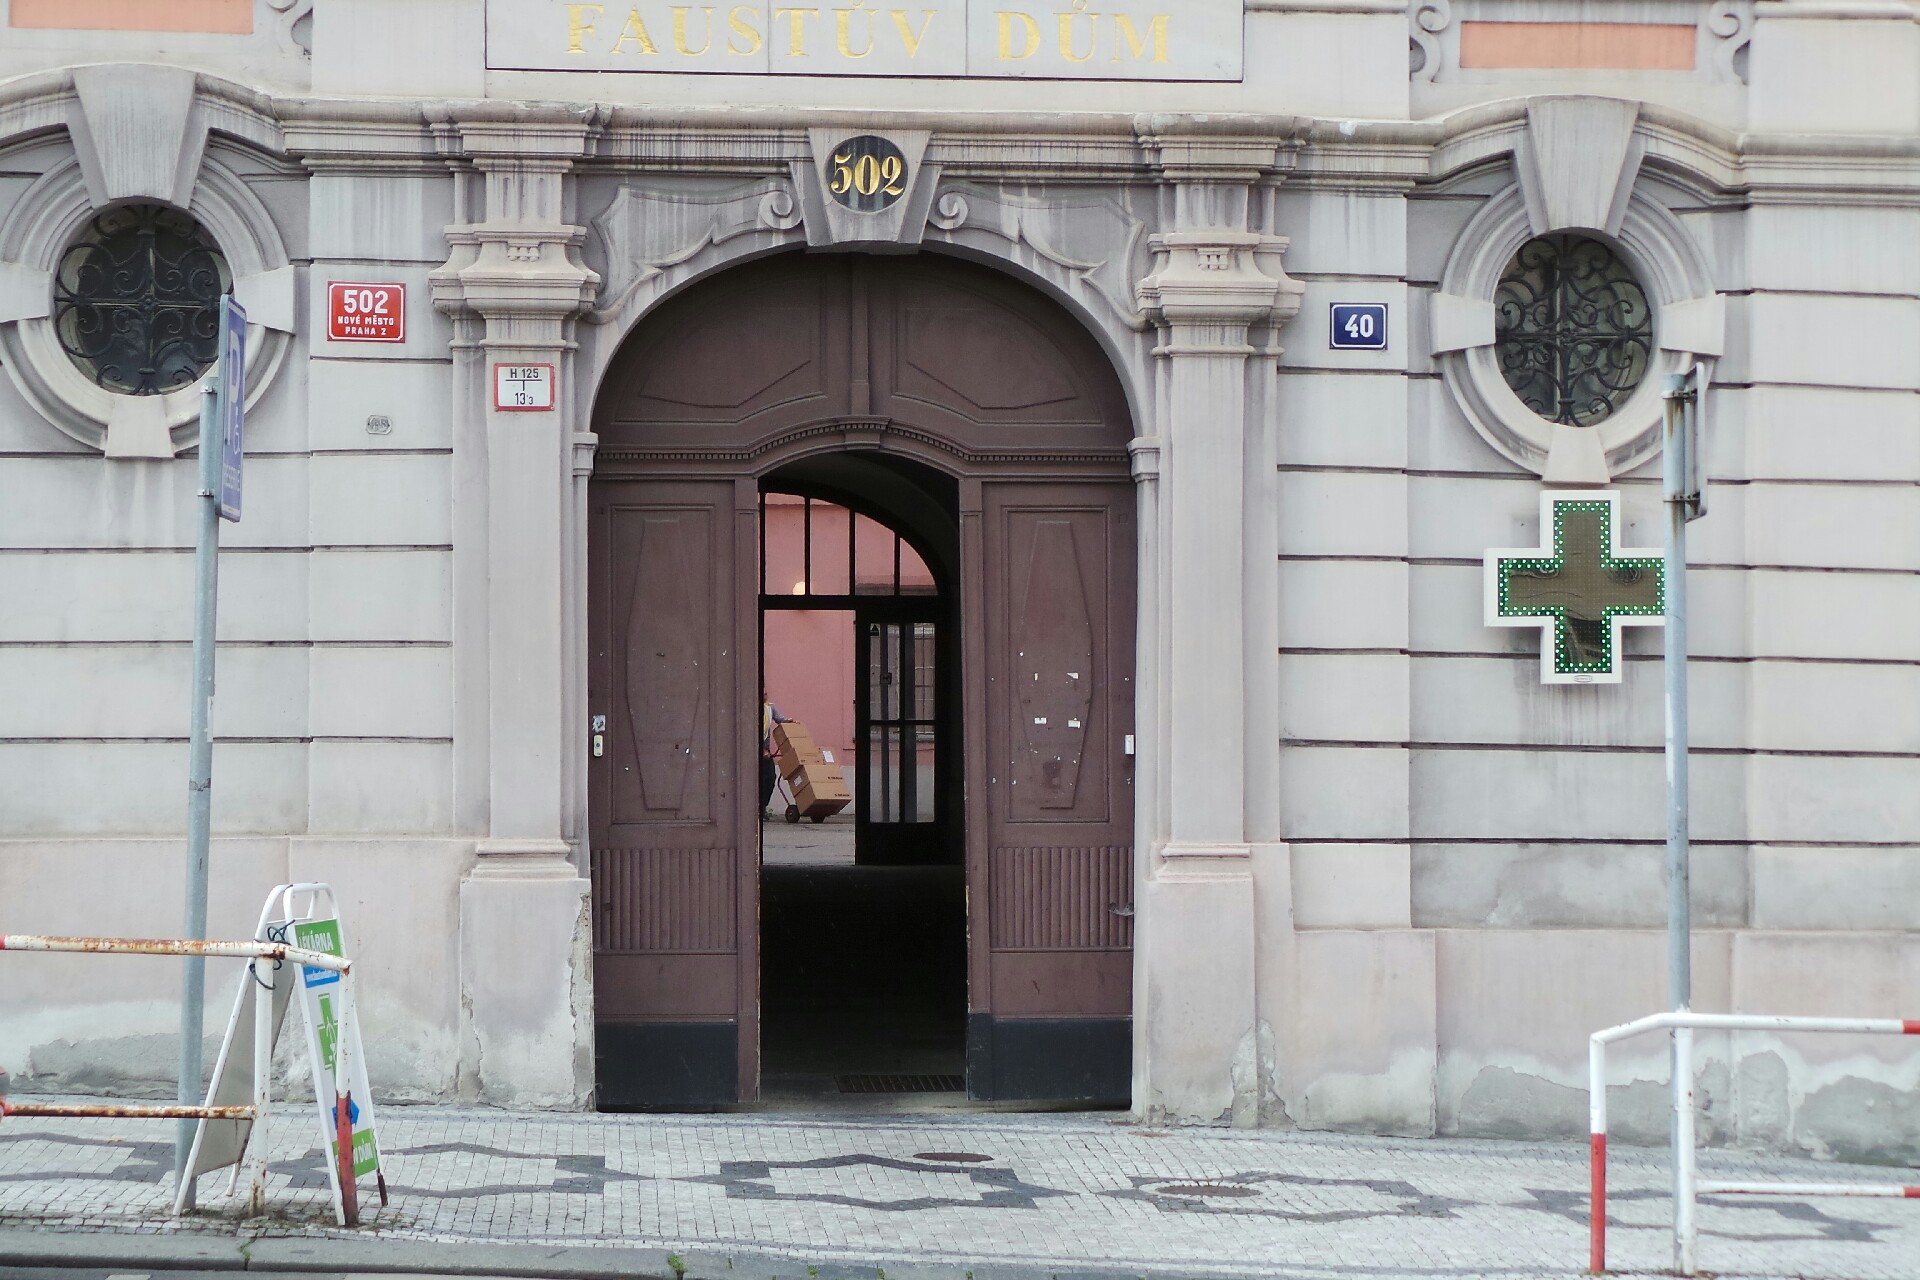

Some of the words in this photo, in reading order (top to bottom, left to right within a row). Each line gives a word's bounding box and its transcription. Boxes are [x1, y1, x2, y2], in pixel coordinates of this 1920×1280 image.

[562, 0, 939, 59] FAUSTŮV
[993, 0, 1171, 63] DŮM
[830, 153, 904, 196] 502
[343, 289, 389, 314] 502
[337, 314, 361, 325] NOVÉ
[364, 314, 394, 326] MĚSTO
[345, 326, 376, 335] PRAHA
[380, 328, 387, 336] 2
[1344, 313, 1374, 338] 40
[510, 368, 517, 378] H
[521, 368, 539, 378] 125
[227, 329, 241, 446] P
